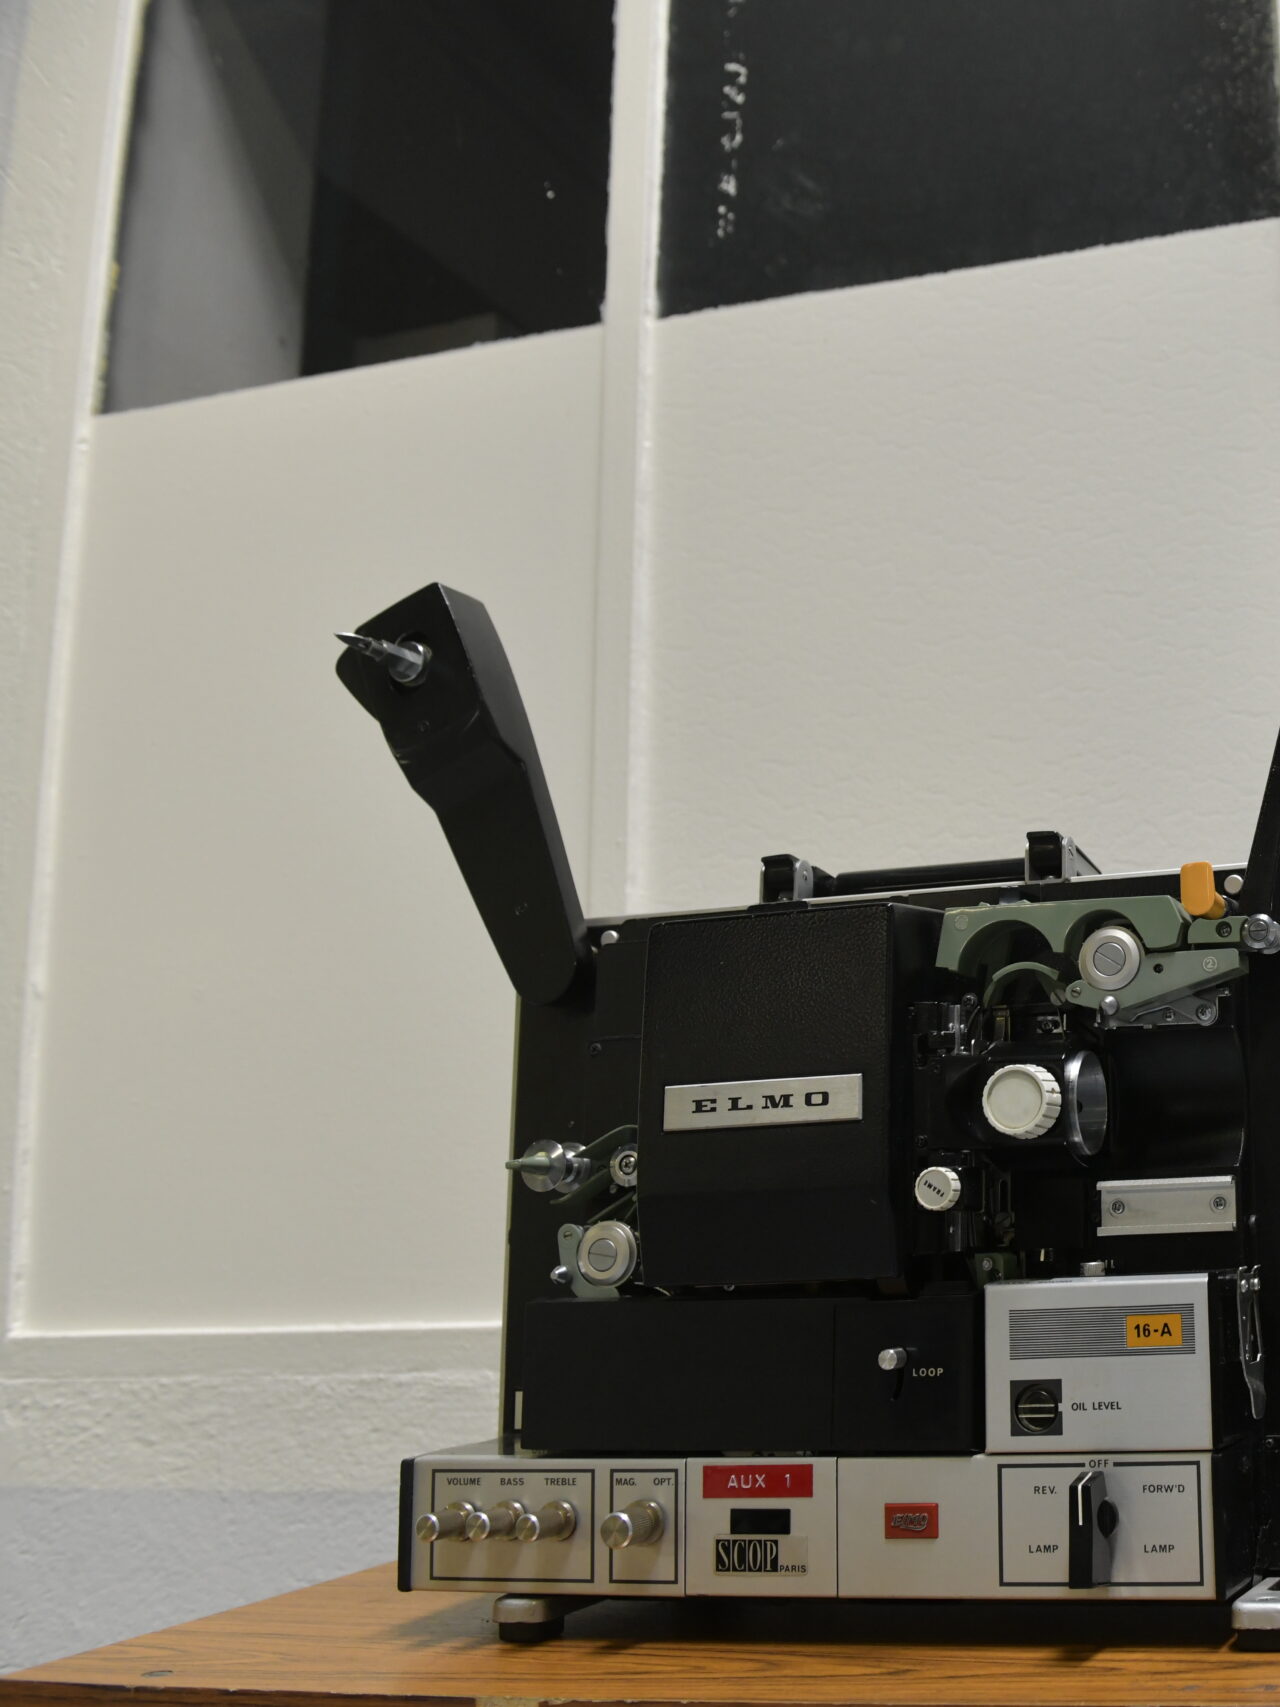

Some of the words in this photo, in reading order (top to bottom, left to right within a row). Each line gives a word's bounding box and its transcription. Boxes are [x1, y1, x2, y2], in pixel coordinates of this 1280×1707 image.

[691, 1090, 830, 1114] ELMO
[1133, 1322, 1174, 1338] 16-A
[912, 1367, 945, 1377] LOOP
[1070, 1402, 1089, 1412] OIL
[1091, 1400, 1123, 1412] LEVEL
[1088, 1458, 1110, 1469] OFF
[446, 1477, 482, 1487] VOLUME
[499, 1477, 526, 1487] BASS
[544, 1477, 578, 1487] TREBLE
[614, 1477, 638, 1487] MAG.
[652, 1477, 674, 1487] OPT.
[726, 1473, 767, 1489] AUX
[783, 1472, 792, 1489] 1
[1033, 1485, 1058, 1495] REV.
[1141, 1483, 1186, 1494] FORW'D
[1027, 1543, 1060, 1554] LAMP
[1143, 1543, 1176, 1554] LAMP
[715, 1539, 778, 1572] SCOP
[779, 1564, 808, 1574] PARIS
